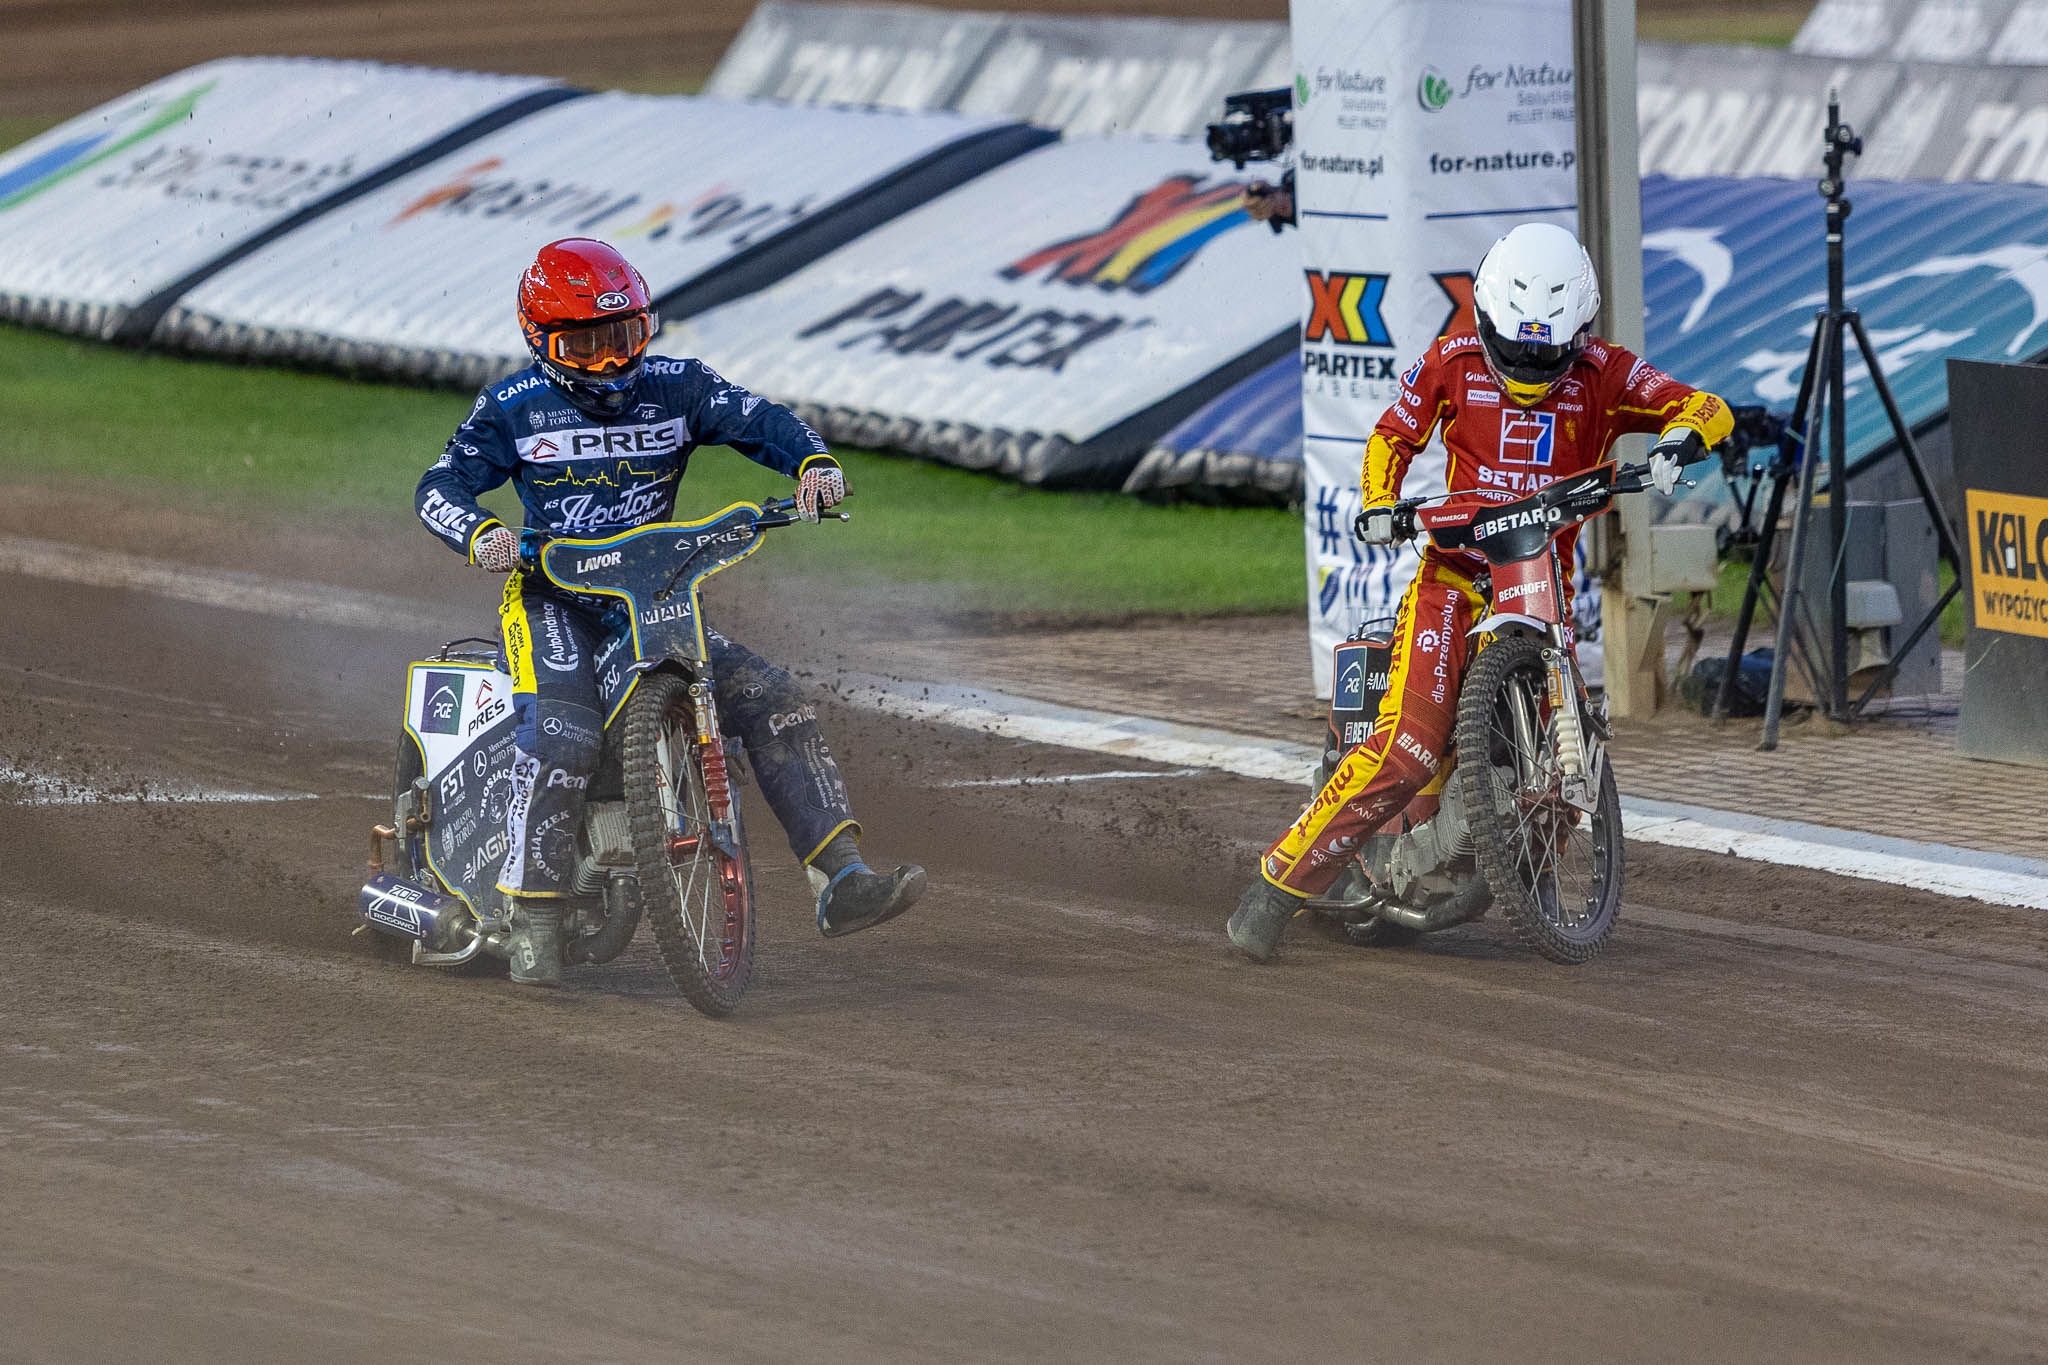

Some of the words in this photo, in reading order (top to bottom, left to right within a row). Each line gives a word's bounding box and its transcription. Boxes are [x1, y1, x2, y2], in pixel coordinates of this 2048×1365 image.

[1505, 62, 1573, 88] Natur
[1430, 150, 1576, 174] for-nature.p
[1304, 352, 1397, 380] PARTEX
[572, 427, 677, 456] PRES
[422, 488, 477, 533] TMC
[544, 499, 560, 511] KS
[1486, 506, 1562, 537] BETARD
[576, 551, 622, 574] LAVOR
[1498, 580, 1548, 603] BECKHOFF
[433, 702, 454, 719] PGE
[467, 697, 506, 737] PRES
[440, 759, 465, 805] FST
[531, 809, 571, 882] PROSIACZEK
[373, 912, 415, 930] ROGOWO
